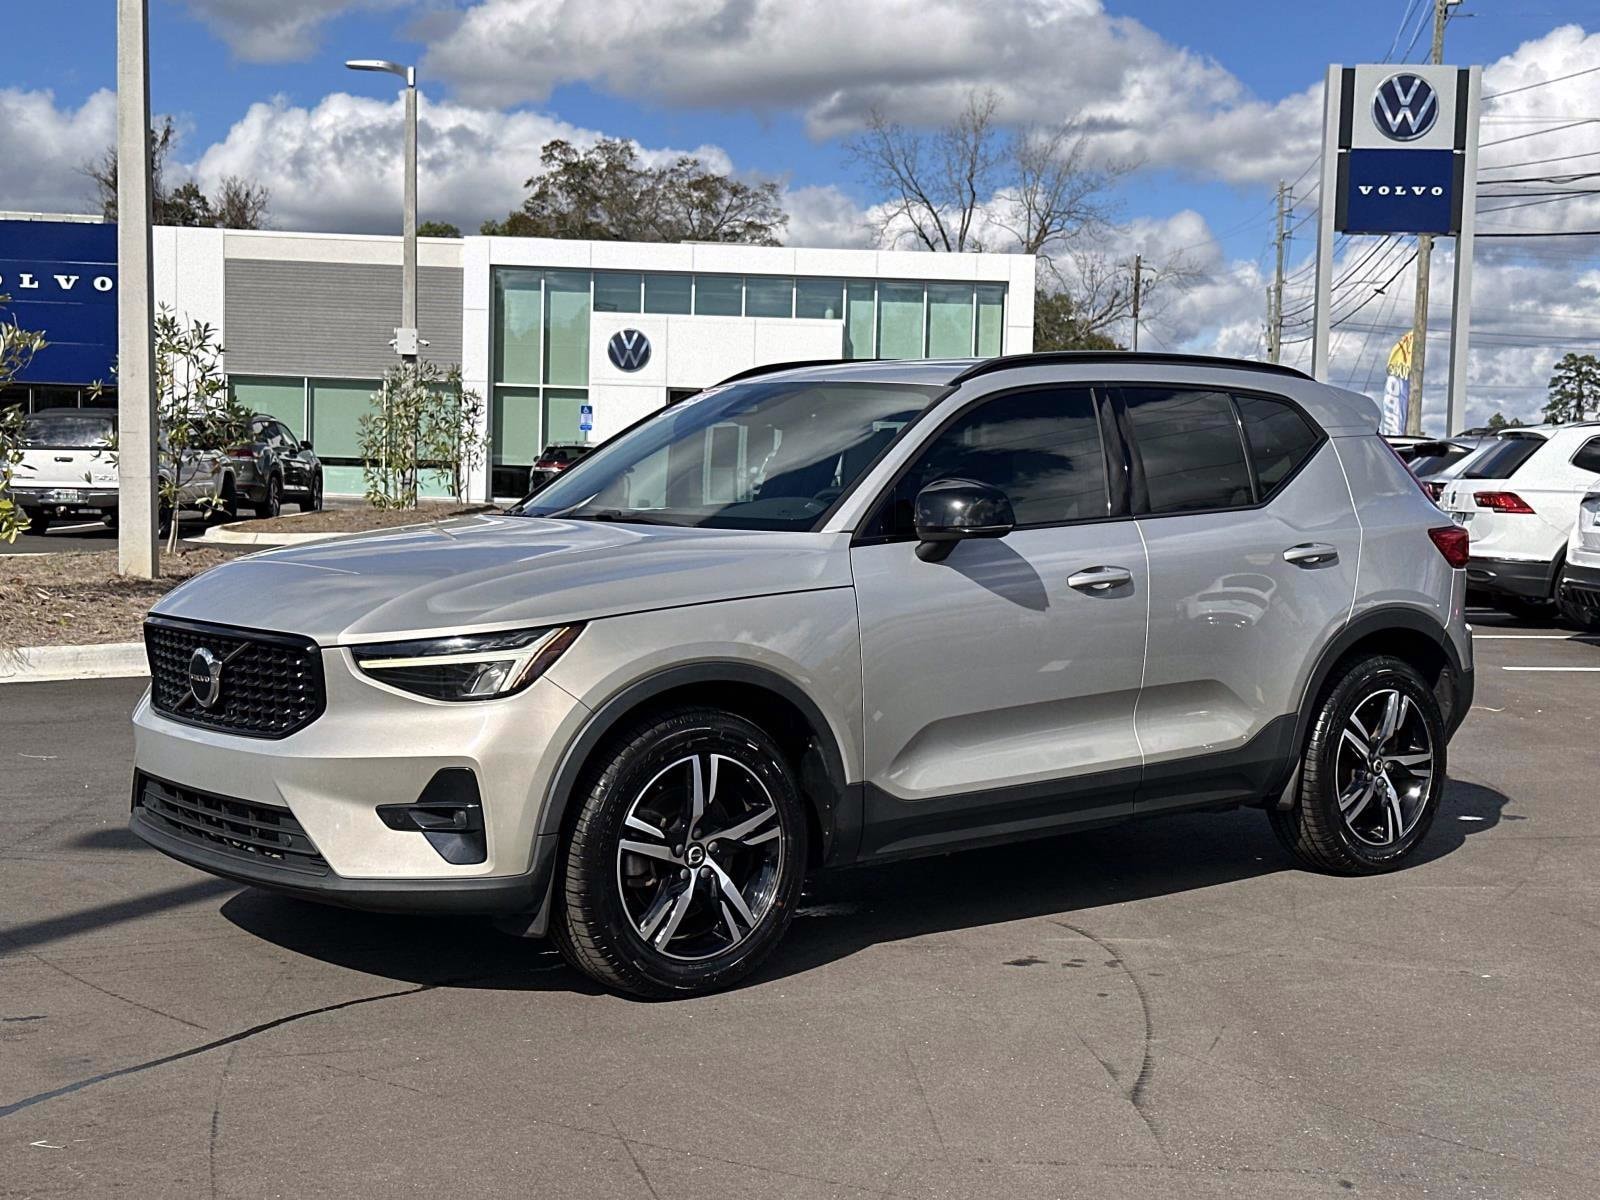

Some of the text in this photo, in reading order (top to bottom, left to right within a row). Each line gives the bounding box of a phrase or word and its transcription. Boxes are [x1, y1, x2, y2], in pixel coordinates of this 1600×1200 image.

[1373, 76, 1436, 134] VW
[1358, 185, 1444, 196] VOLVO
[0, 273, 114, 292] LVO
[609, 330, 649, 368] VW
